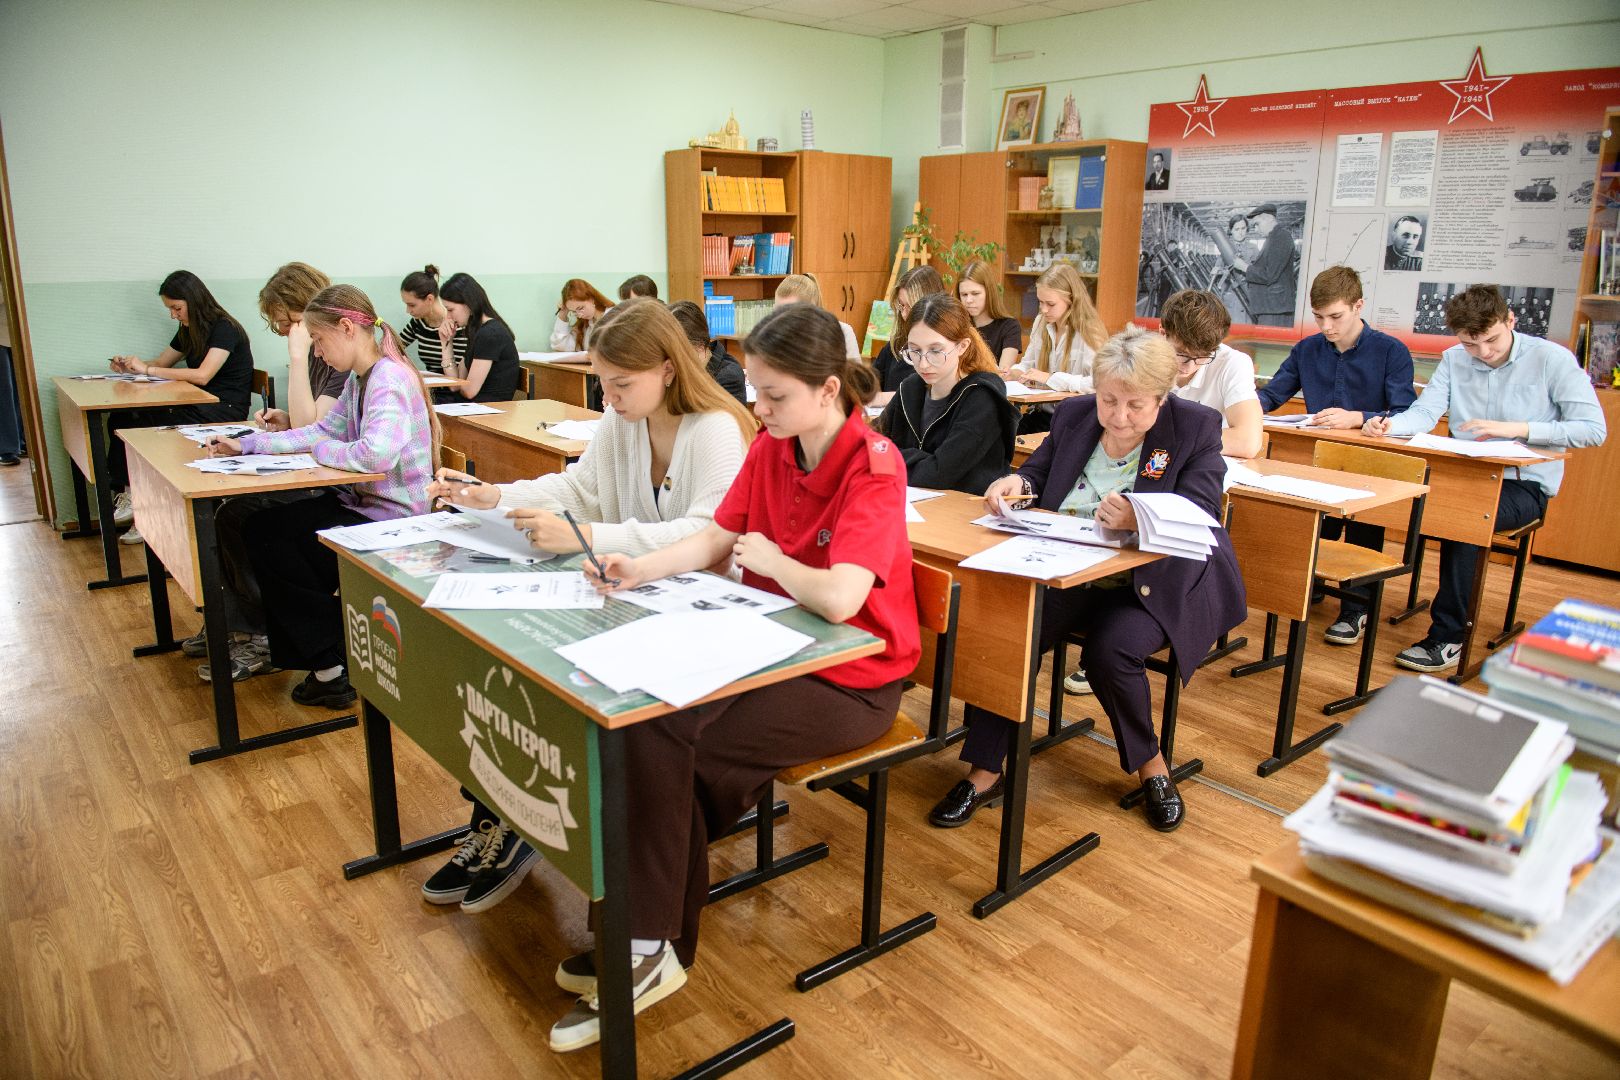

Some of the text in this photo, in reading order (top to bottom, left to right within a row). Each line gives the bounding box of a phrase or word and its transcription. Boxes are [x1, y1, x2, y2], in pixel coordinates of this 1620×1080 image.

[1193, 105, 1209, 113] 1938
[1367, 97, 1392, 105] ВЫПУСК
[373, 633, 396, 663] ПРОЕКТ
[374, 652, 397, 681] НОВАЯ
[376, 670, 401, 702] ШКОЛА
[466, 682, 562, 781] ПАРТА ГЕРОЯ
